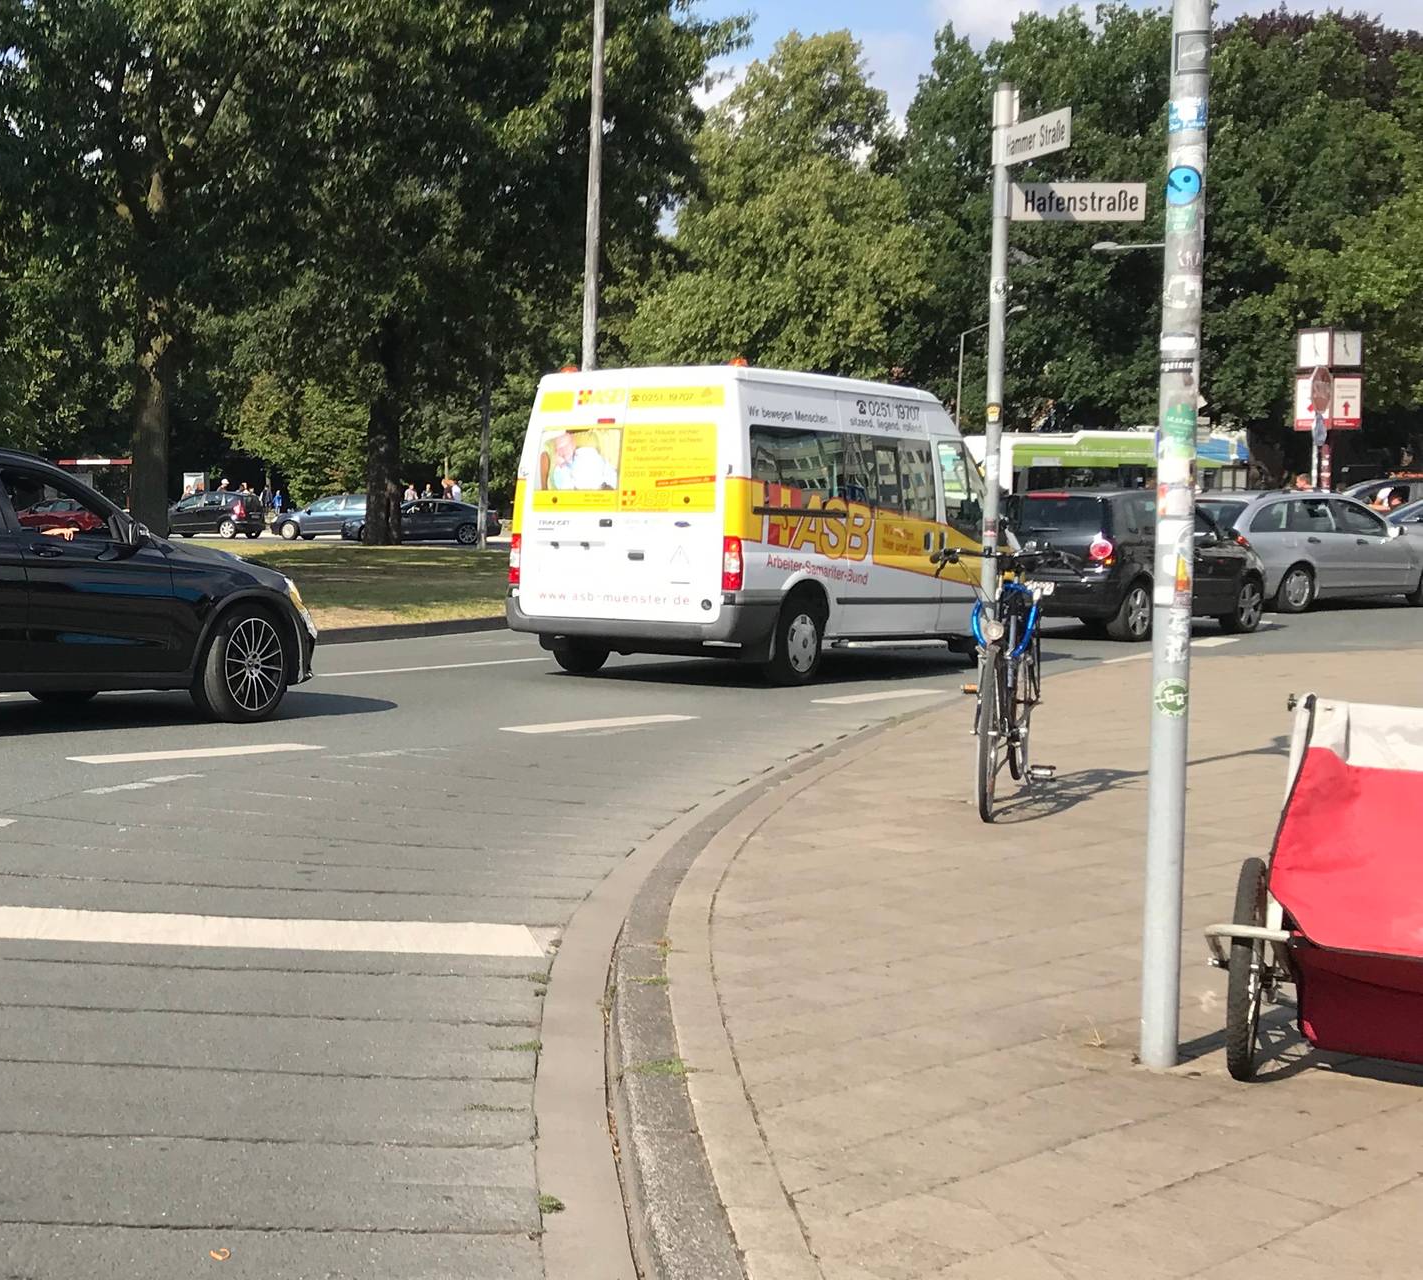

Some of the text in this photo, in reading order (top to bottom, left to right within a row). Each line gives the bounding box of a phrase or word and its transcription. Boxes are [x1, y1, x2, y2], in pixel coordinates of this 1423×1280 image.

[1039, 119, 1066, 148] Straße
[1024, 189, 1139, 213] Hafenstraße
[747, 405, 759, 417] Wir
[762, 407, 793, 421] bewegen
[790, 494, 872, 561] ASB
[766, 553, 869, 586] Arbeiter-Samariter-Bund
